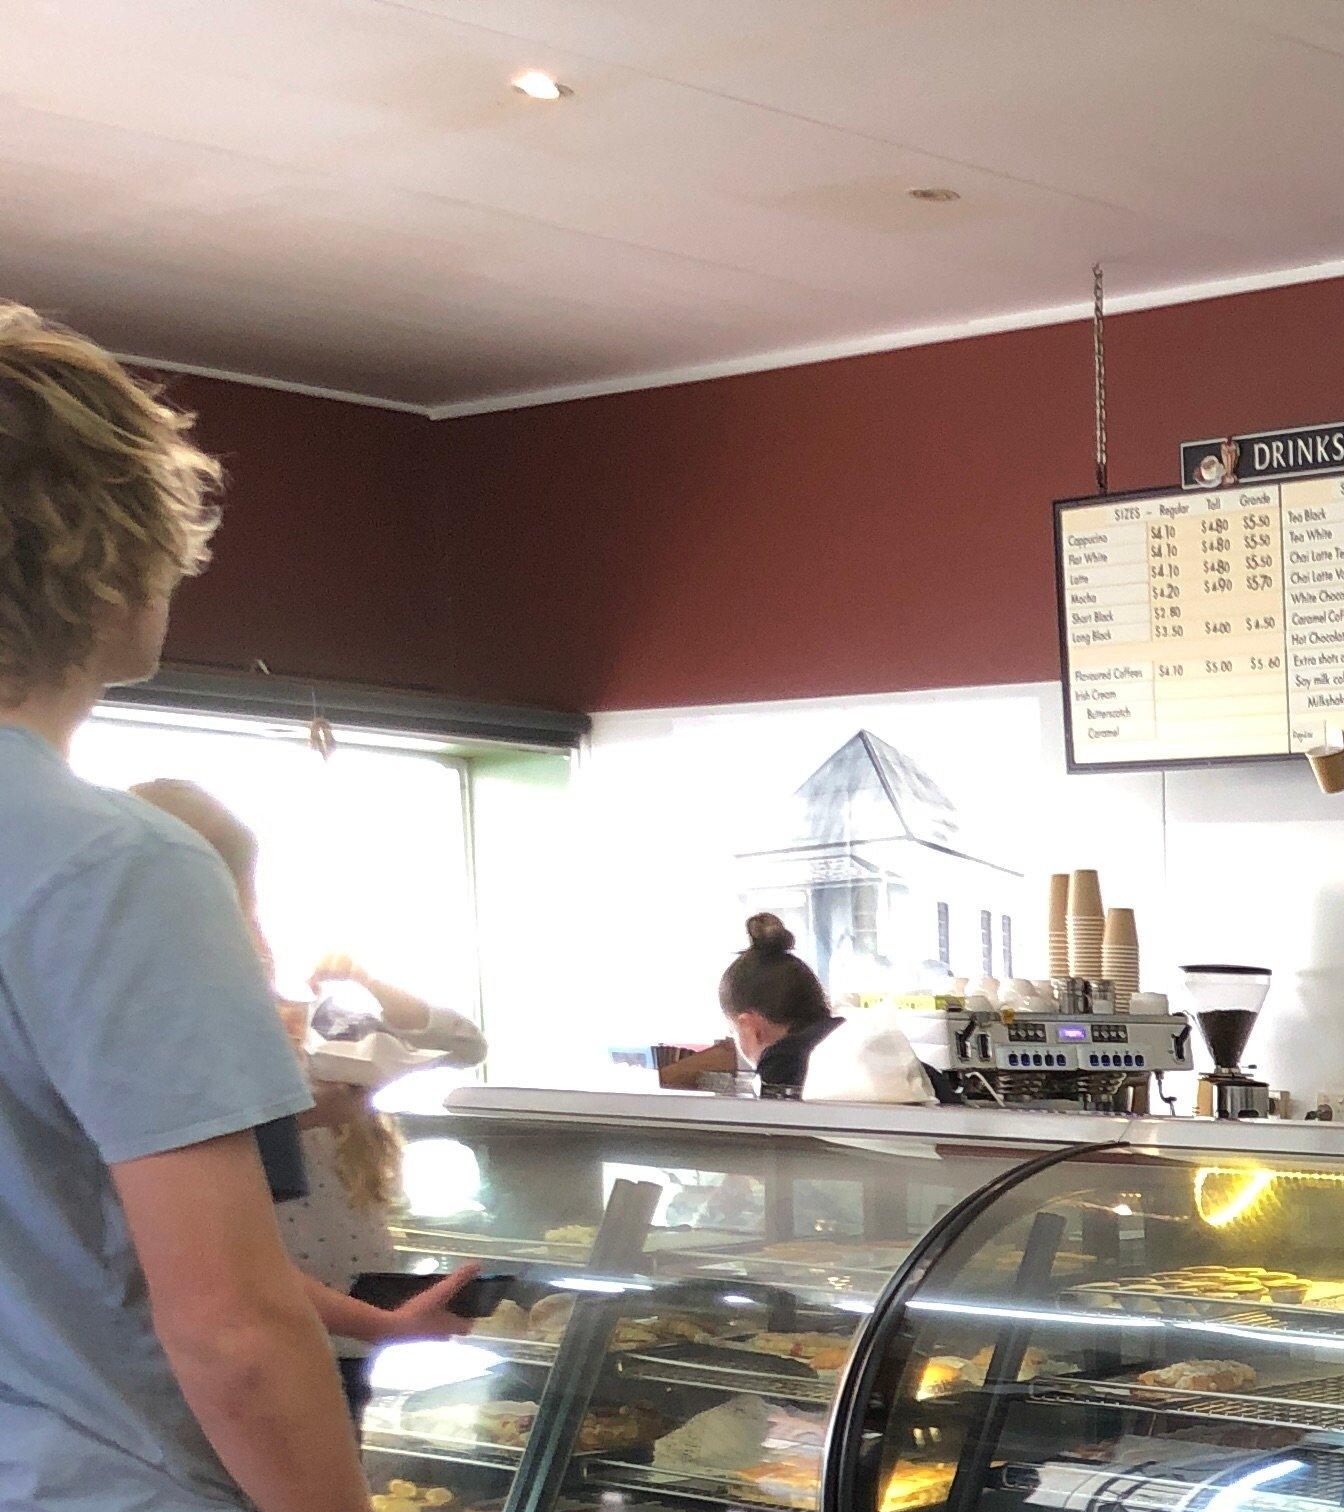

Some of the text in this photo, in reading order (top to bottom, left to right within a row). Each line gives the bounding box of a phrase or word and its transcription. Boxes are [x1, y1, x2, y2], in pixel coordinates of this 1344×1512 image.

[1254, 432, 1344, 470] DRINKS
[1287, 510, 1302, 523] Tea
[1304, 508, 1326, 520] Black
[1289, 531, 1304, 543] Tea
[1307, 528, 1332, 540] White
[1291, 592, 1316, 605] White
[1292, 611, 1326, 626] Caramel
[1291, 634, 1306, 645] Hot
[1294, 656, 1316, 667] Extra
[1319, 653, 1338, 665] shots
[1295, 675, 1311, 689] Soy
[1314, 674, 1329, 685] milk
